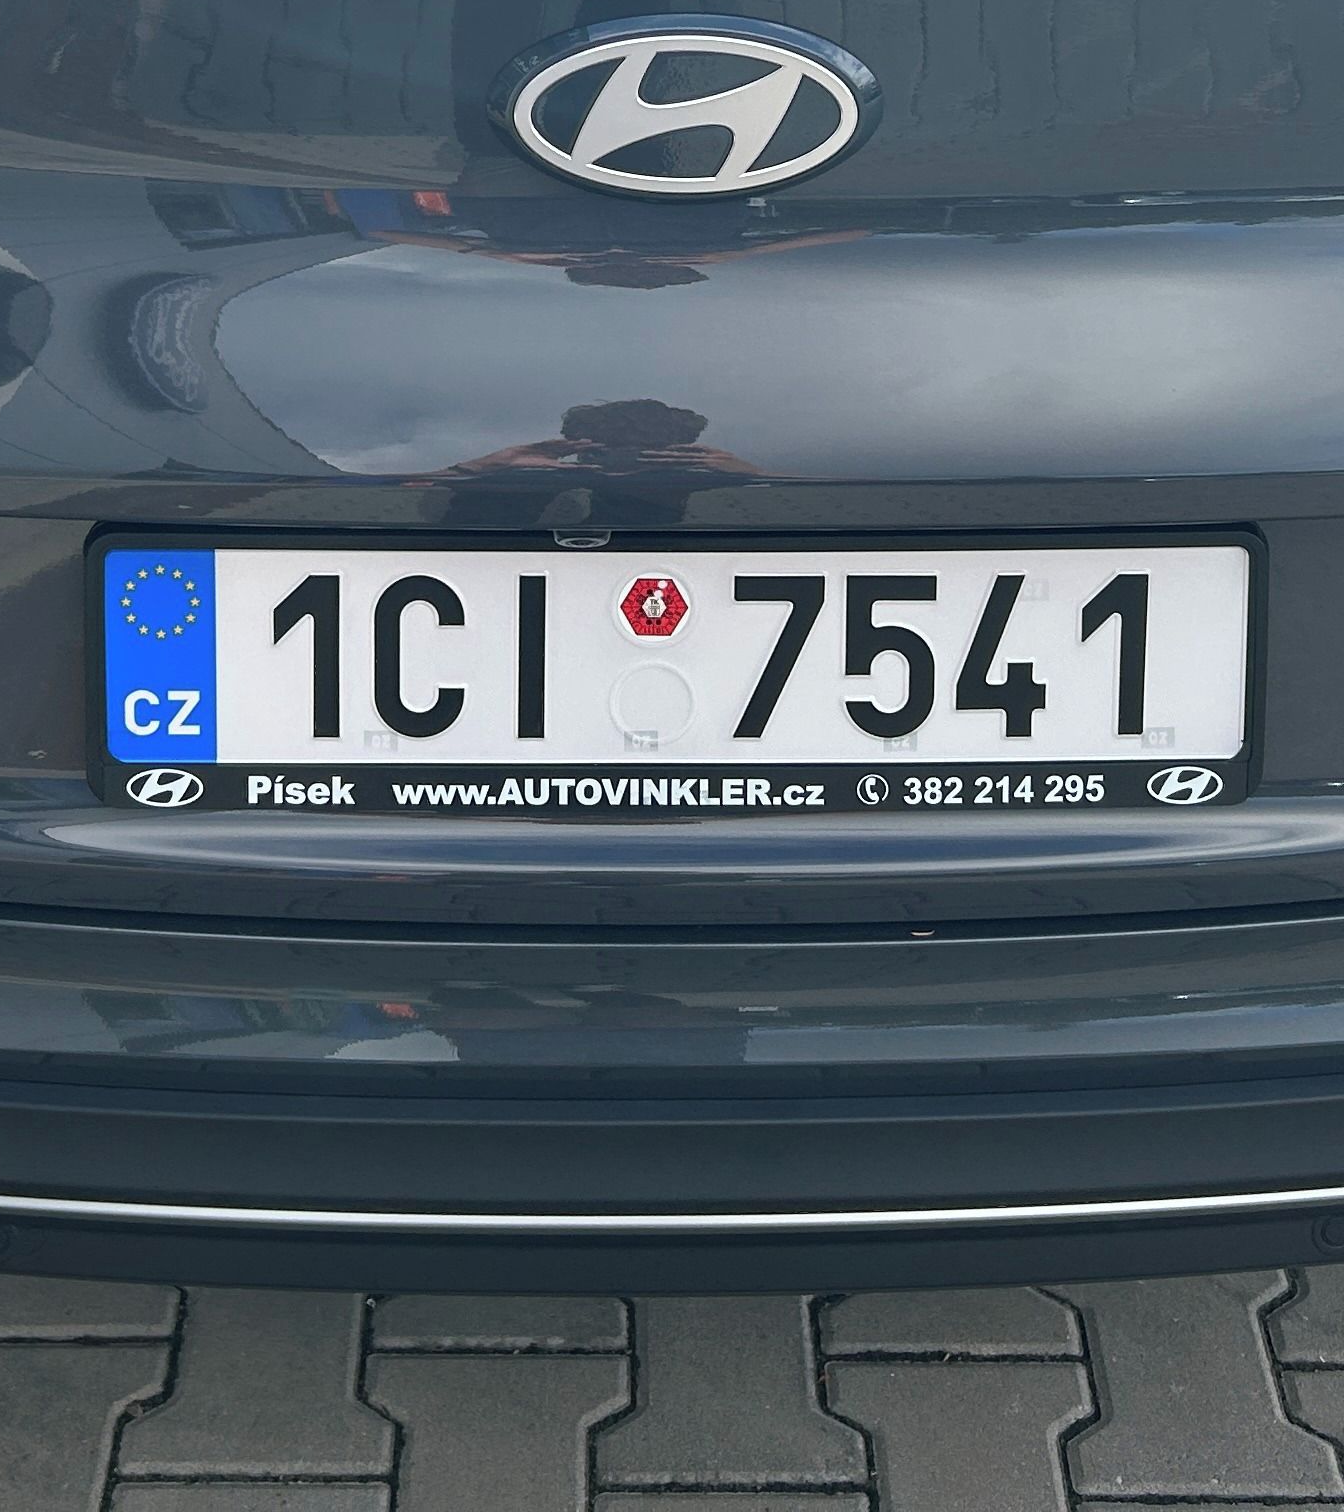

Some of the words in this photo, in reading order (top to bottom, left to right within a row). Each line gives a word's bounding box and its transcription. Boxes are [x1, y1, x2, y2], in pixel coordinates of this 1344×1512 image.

[273, 573, 546, 739] 1CI
[733, 572, 1149, 740] 7541
[124, 689, 200, 735] CZ
[248, 775, 356, 805] Písek
[392, 778, 824, 806] www.AUTOVINKLER.cz
[903, 776, 963, 805] 382
[974, 775, 1034, 804] 214
[1045, 774, 1105, 803] 295
